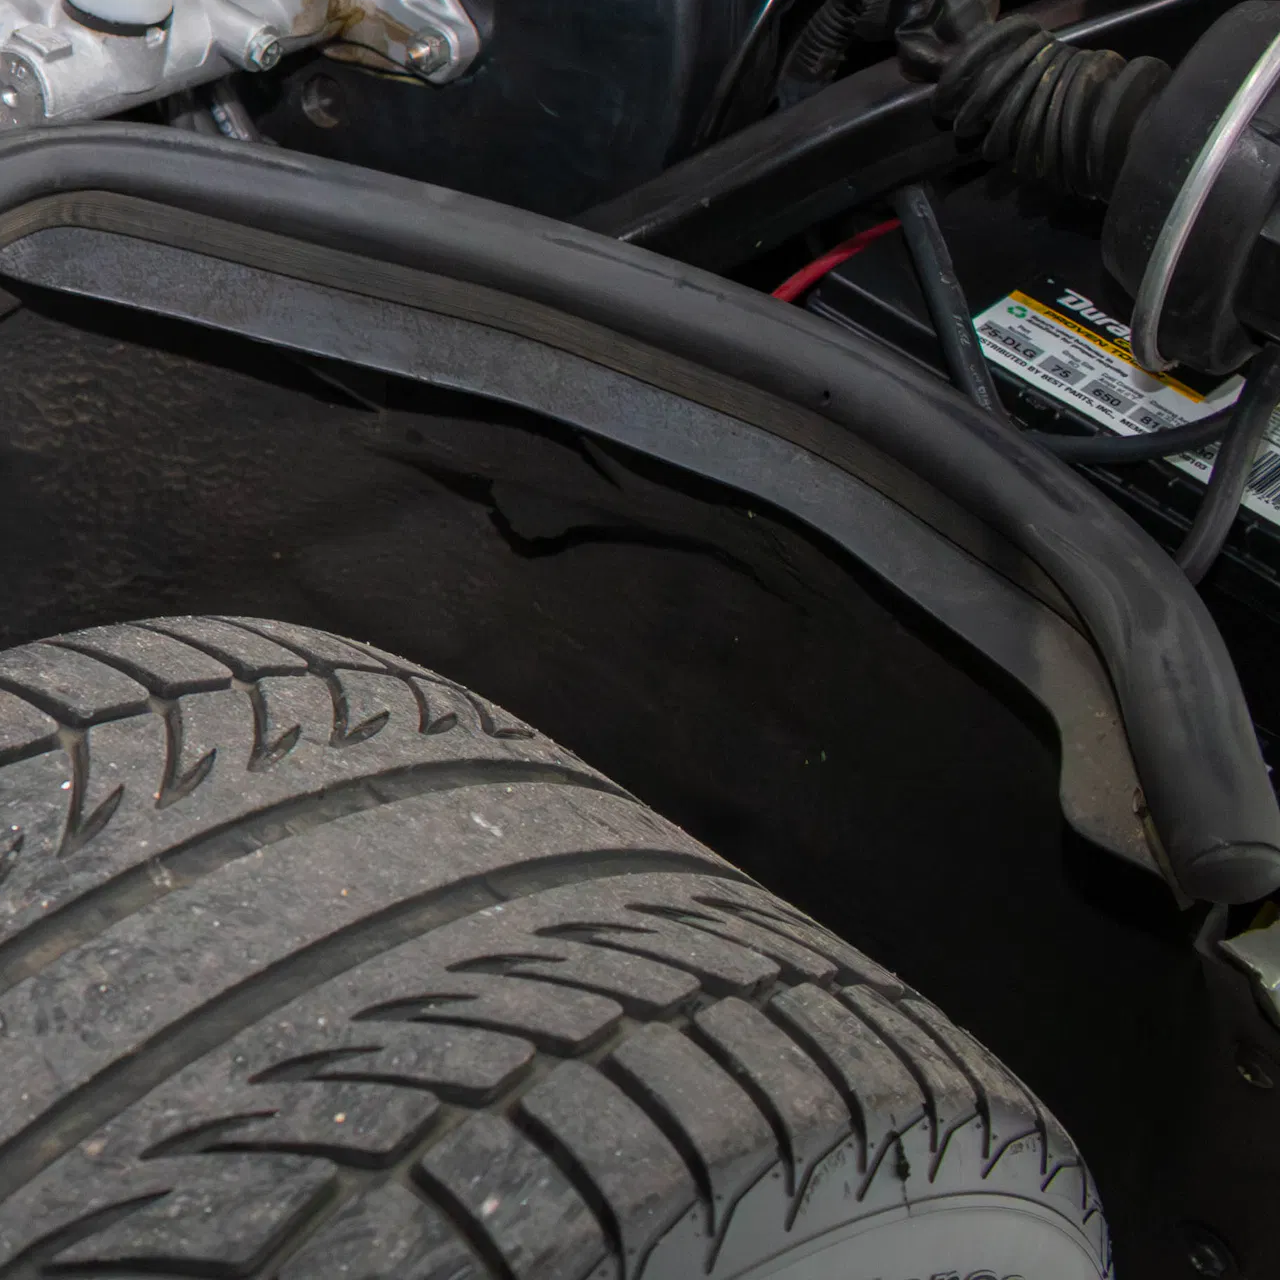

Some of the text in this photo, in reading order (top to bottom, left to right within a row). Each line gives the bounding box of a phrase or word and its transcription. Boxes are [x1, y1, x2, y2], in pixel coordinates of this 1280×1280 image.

[1044, 310, 1109, 347] PROVEN
[1055, 289, 1139, 338] Dura
[979, 325, 1037, 359] 75-DLG
[1027, 366, 1040, 374] BY
[1040, 373, 1063, 387] BEST
[1063, 387, 1095, 405] PARTS,
[1051, 365, 1071, 378] 75
[1091, 388, 1122, 407] 650
[1139, 415, 1160, 428] 81
